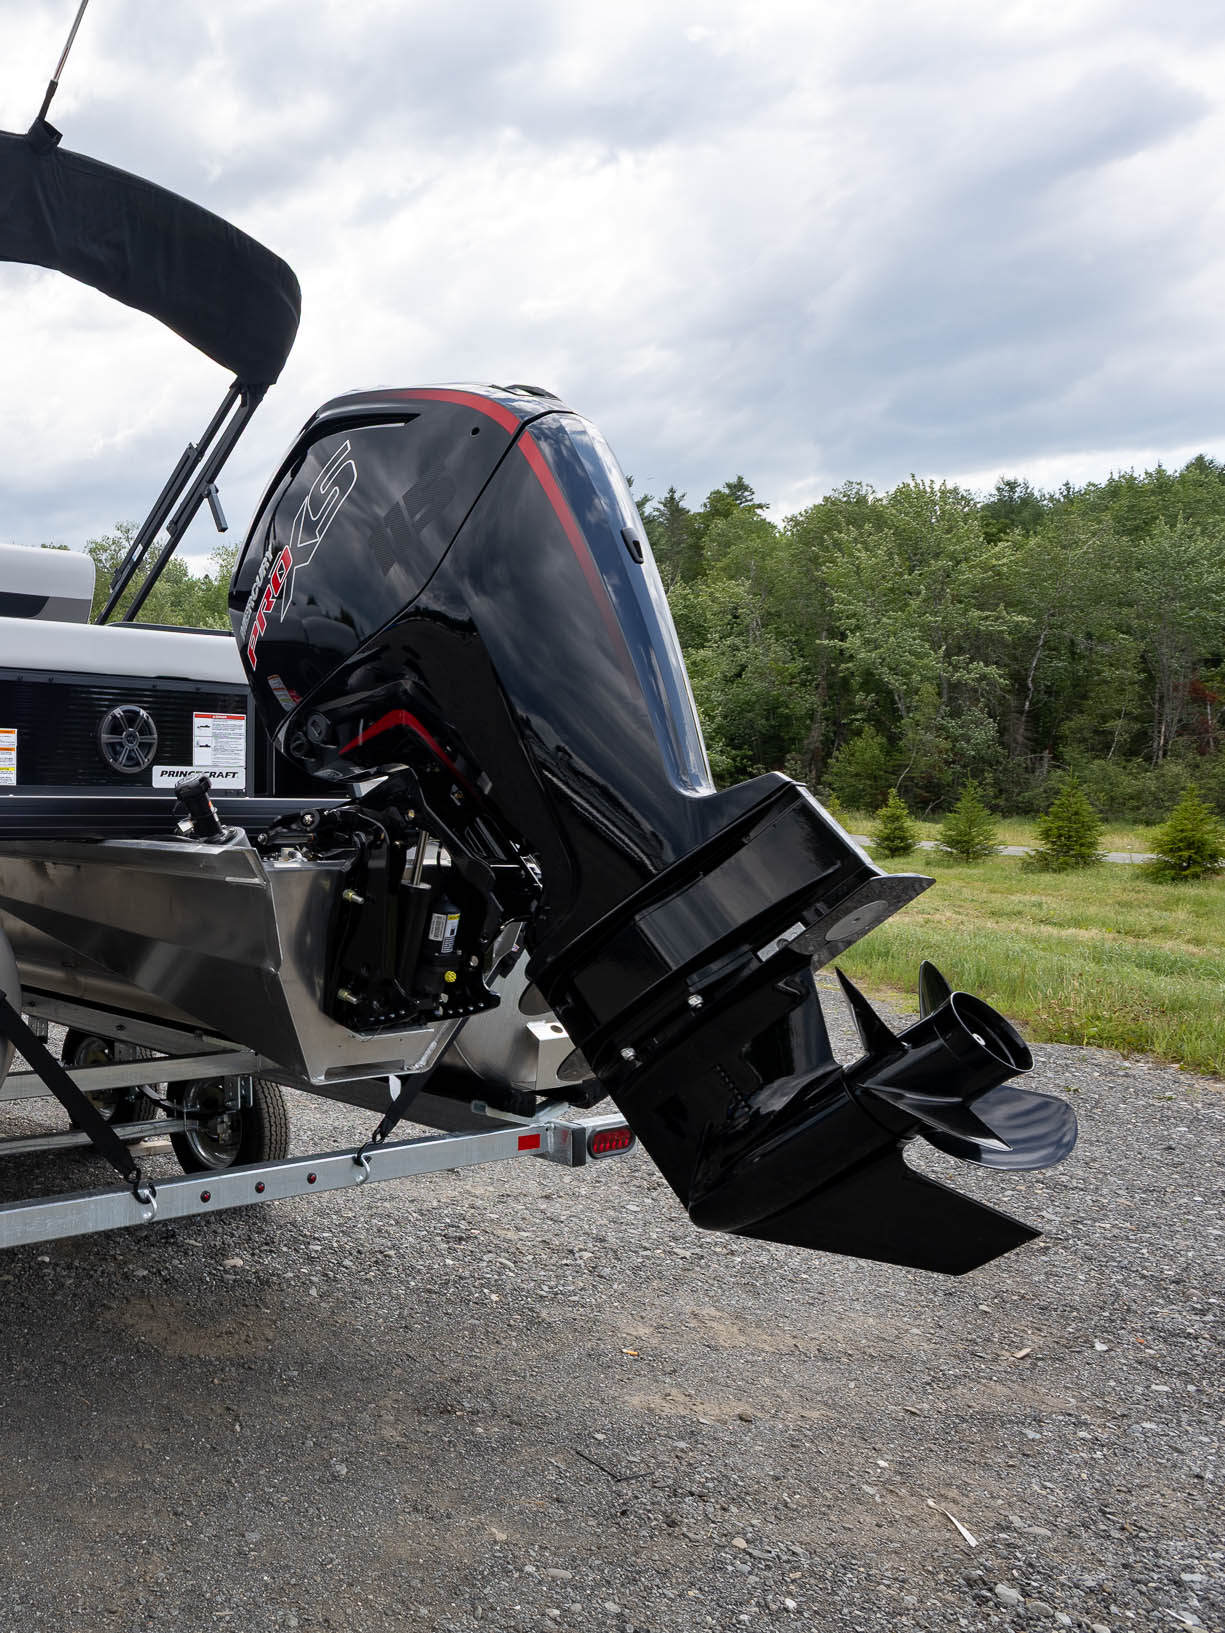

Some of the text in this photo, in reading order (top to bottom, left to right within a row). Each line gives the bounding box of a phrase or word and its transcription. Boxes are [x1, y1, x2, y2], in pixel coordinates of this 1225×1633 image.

[240, 542, 273, 641] MERCURY
[248, 440, 357, 671] PRO XS
[160, 770, 239, 779] PRINRAFT
